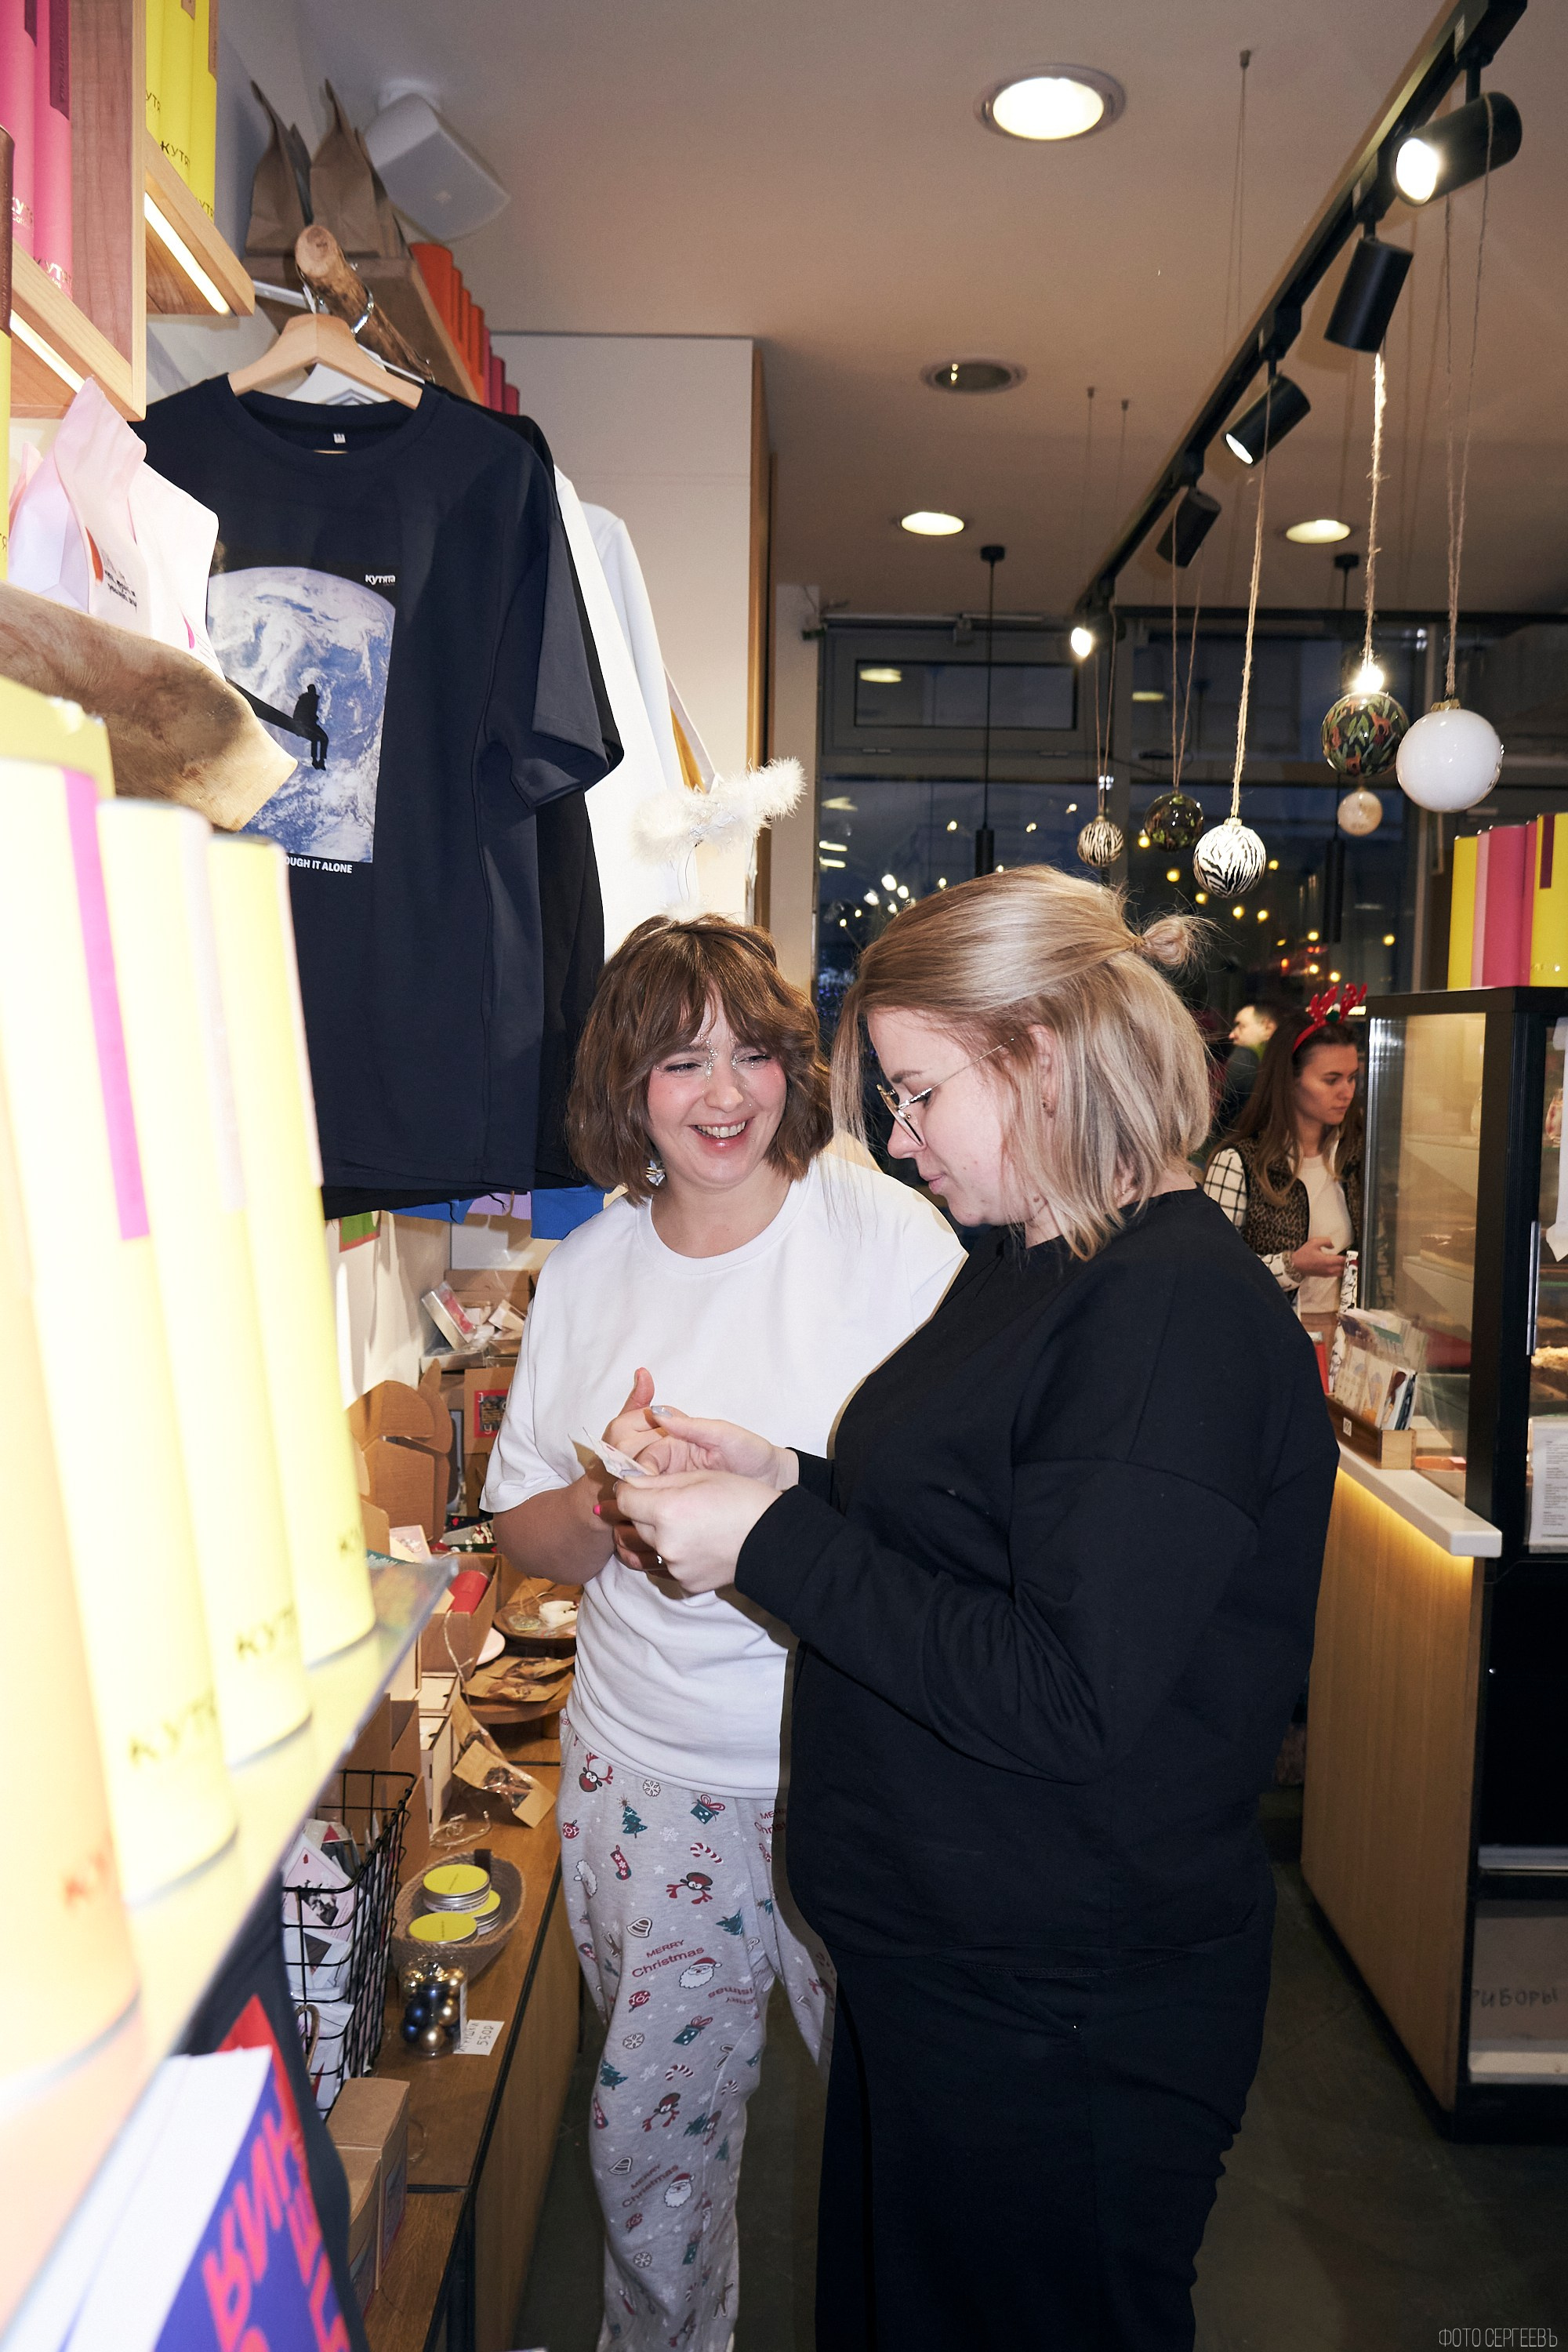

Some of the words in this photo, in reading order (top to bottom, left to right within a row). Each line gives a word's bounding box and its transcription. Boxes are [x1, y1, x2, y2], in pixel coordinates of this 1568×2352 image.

[312, 860, 321, 869] IT
[321, 862, 353, 873] ALONE
[632, 1947, 705, 1977] Christmas
[646, 1940, 684, 1958] MERRY
[622, 2165, 679, 2208] Christmas
[630, 2164, 660, 2190] MERRY
